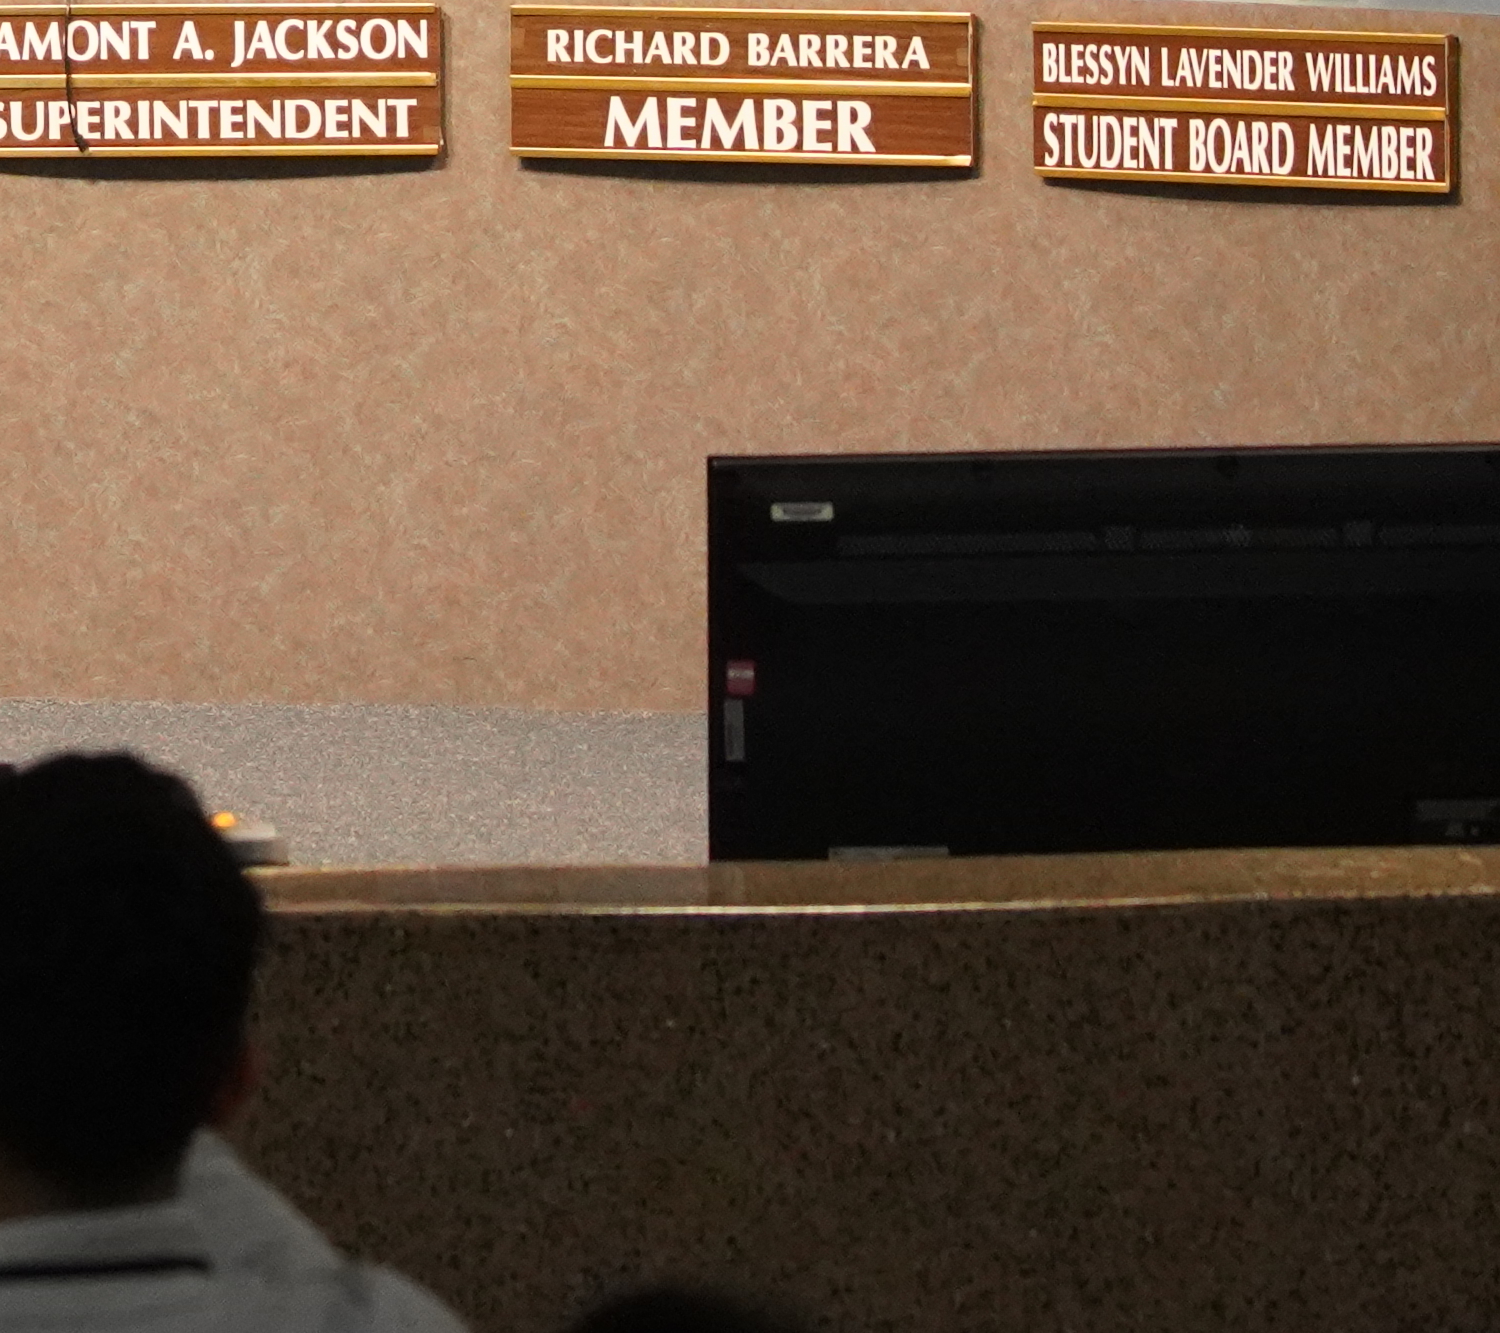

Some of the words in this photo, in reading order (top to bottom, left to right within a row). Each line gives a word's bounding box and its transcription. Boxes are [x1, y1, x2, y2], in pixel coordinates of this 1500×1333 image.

[172, 20, 214, 61] A.
[230, 18, 429, 68] JACKSON
[546, 29, 730, 67] RICHARD
[747, 33, 930, 70] BARRERA
[1041, 43, 1150, 87] BLESSYN
[1161, 49, 1295, 92] LAVENDER
[1305, 53, 1437, 96] WILLIAMS
[603, 95, 876, 153] MEMBER
[1043, 113, 1178, 171] STUDENT
[1188, 118, 1295, 177] BOARD
[1306, 124, 1436, 182] MEMBER
